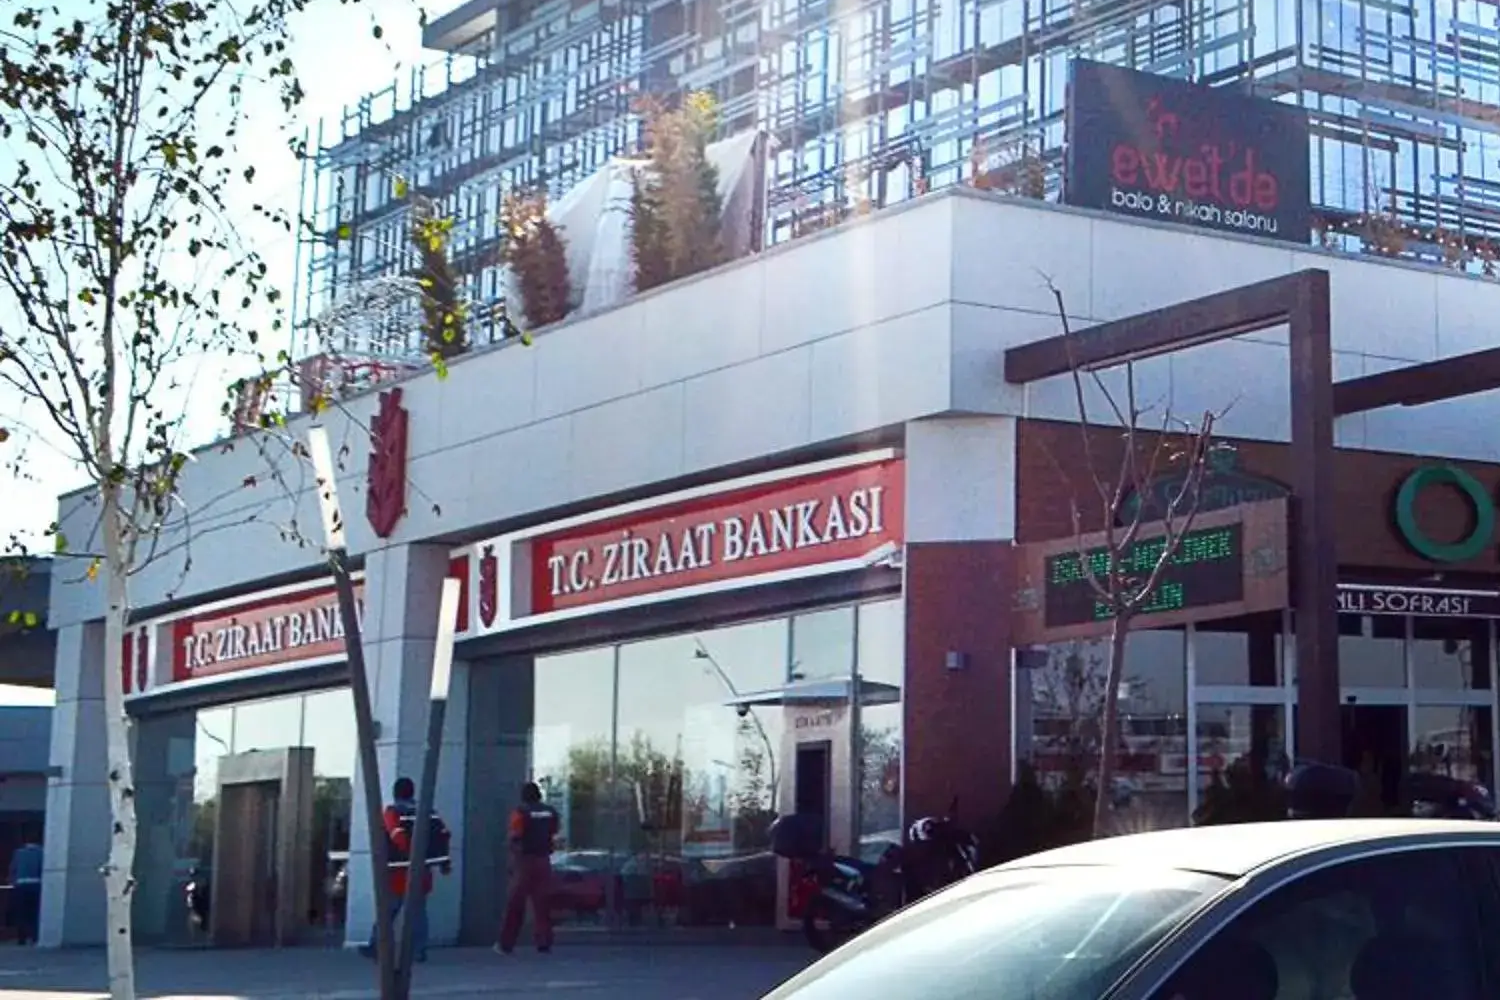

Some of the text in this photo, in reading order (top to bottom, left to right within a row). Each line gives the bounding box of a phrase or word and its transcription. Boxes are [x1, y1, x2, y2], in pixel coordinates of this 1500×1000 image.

[1112, 187, 1153, 211] balo
[1157, 194, 1171, 214] &
[1224, 210, 1278, 233] salonu
[548, 486, 884, 596] T.C. ZİRAAT BANKASI
[1372, 592, 1472, 614] SOFRASI
[184, 635, 214, 669] T.C.
[216, 616, 285, 662] ZİRAAT
